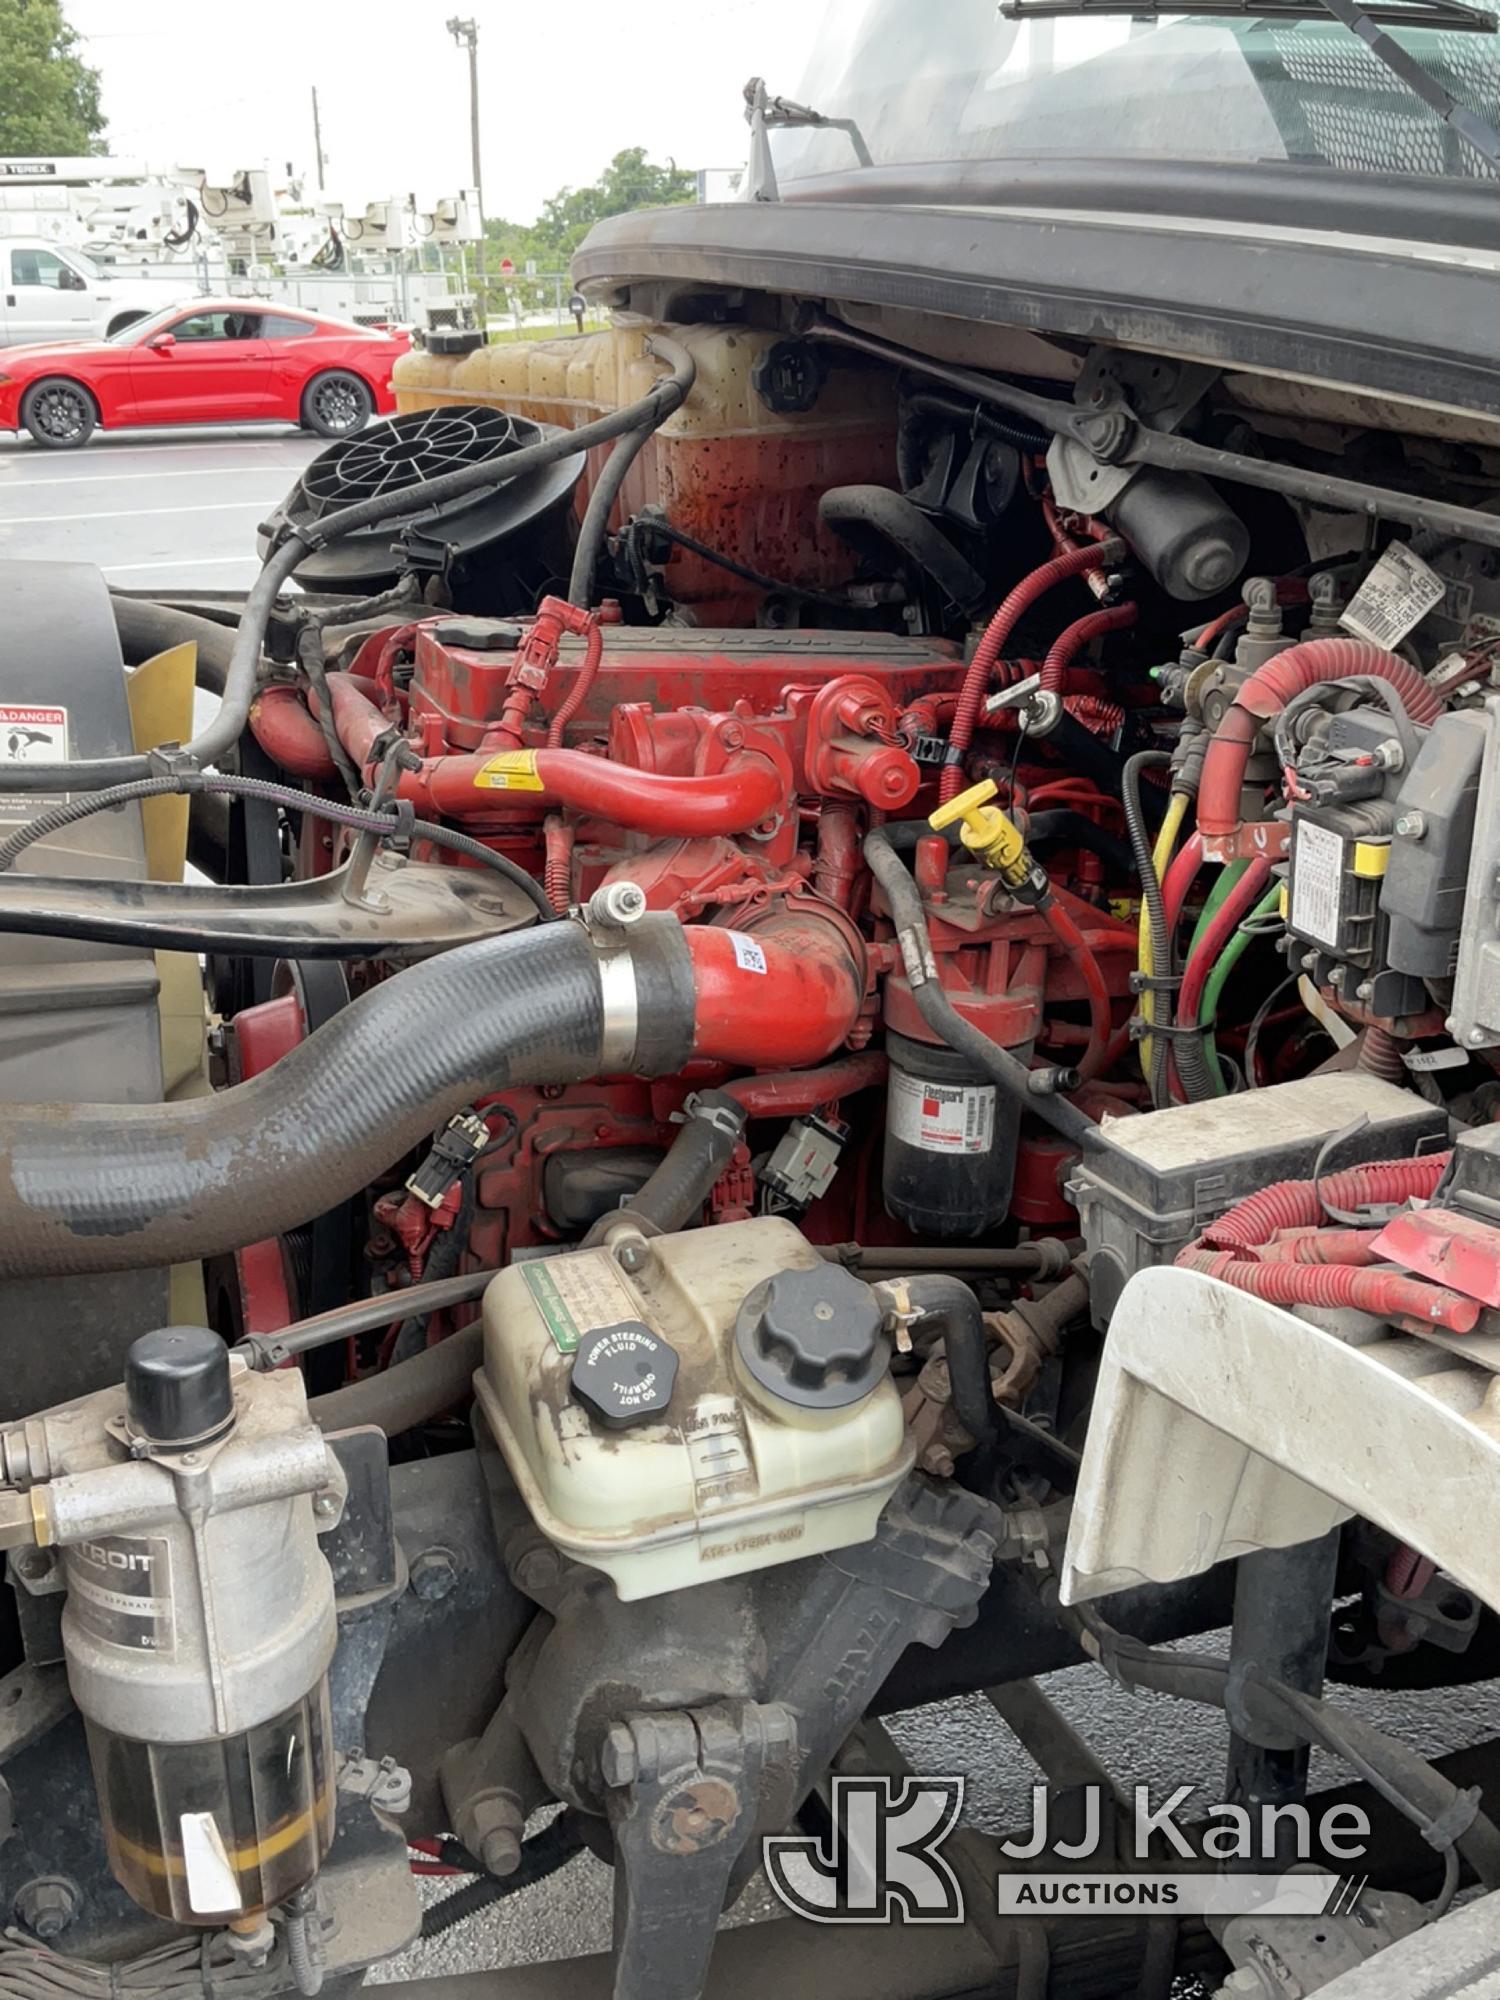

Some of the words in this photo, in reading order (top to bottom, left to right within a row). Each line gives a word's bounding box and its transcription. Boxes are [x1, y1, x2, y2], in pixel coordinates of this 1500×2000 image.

[9, 711, 63, 722] DANGER
[924, 1085, 964, 1104] Fleetguard
[587, 1337, 611, 1367] POWER
[611, 1332, 658, 1352] STEERING
[604, 1342, 637, 1358] FLUID
[612, 1372, 656, 1395] OVERFILL
[619, 1395, 641, 1405] NOT
[642, 1390, 656, 1401] DO
